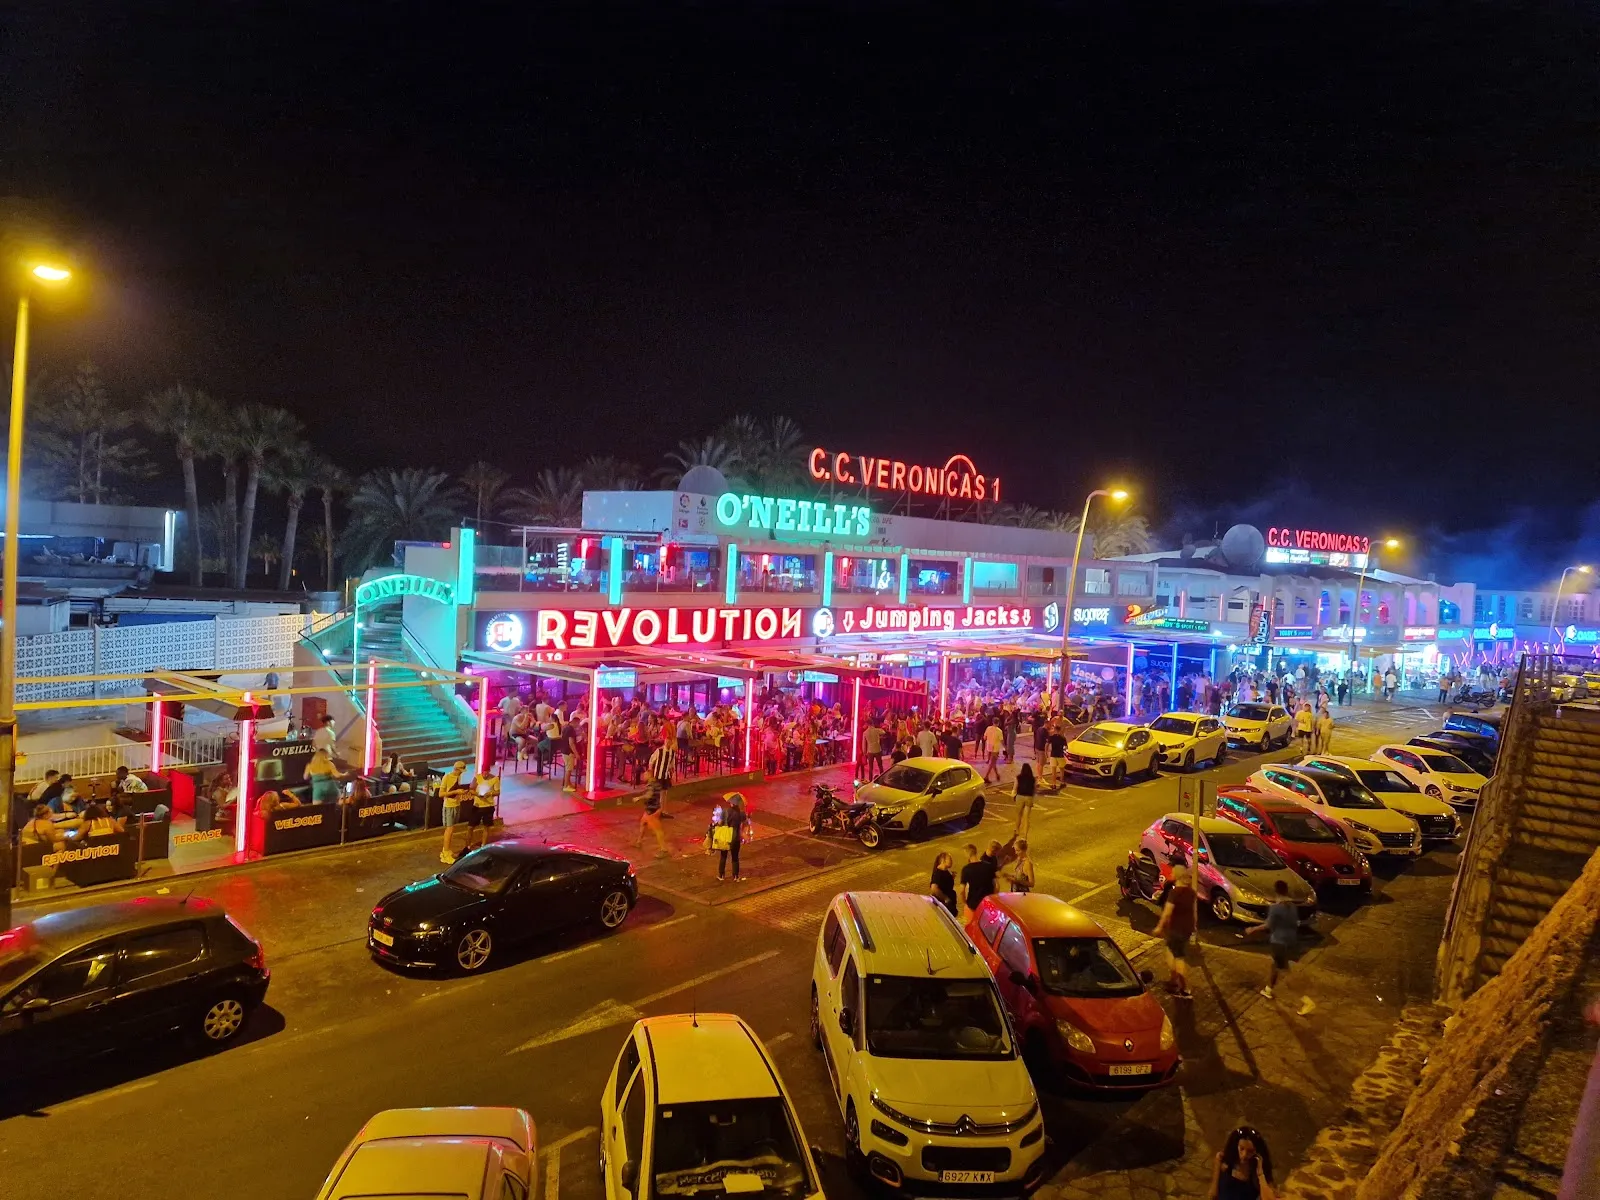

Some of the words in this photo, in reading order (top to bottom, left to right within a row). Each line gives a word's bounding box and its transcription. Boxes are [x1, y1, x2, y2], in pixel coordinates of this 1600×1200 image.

[808, 447, 855, 484] C.C.
[859, 455, 986, 501] VERONICAS
[992, 477, 1001, 502] 1
[715, 492, 871, 537] O'NEILL'S
[1268, 527, 1293, 547] C.C.
[1295, 529, 1360, 552] VERONICAS
[1361, 536, 1369, 553] 3
[536, 607, 801, 650] REVOLUTION
[859, 606, 956, 634] Jumping
[961, 605, 1020, 627] Jacks
[275, 814, 323, 831] WELCOME
[173, 829, 223, 846] TERRACE
[944, 1171, 970, 1183] 6927
[973, 1172, 992, 1183] KWX
